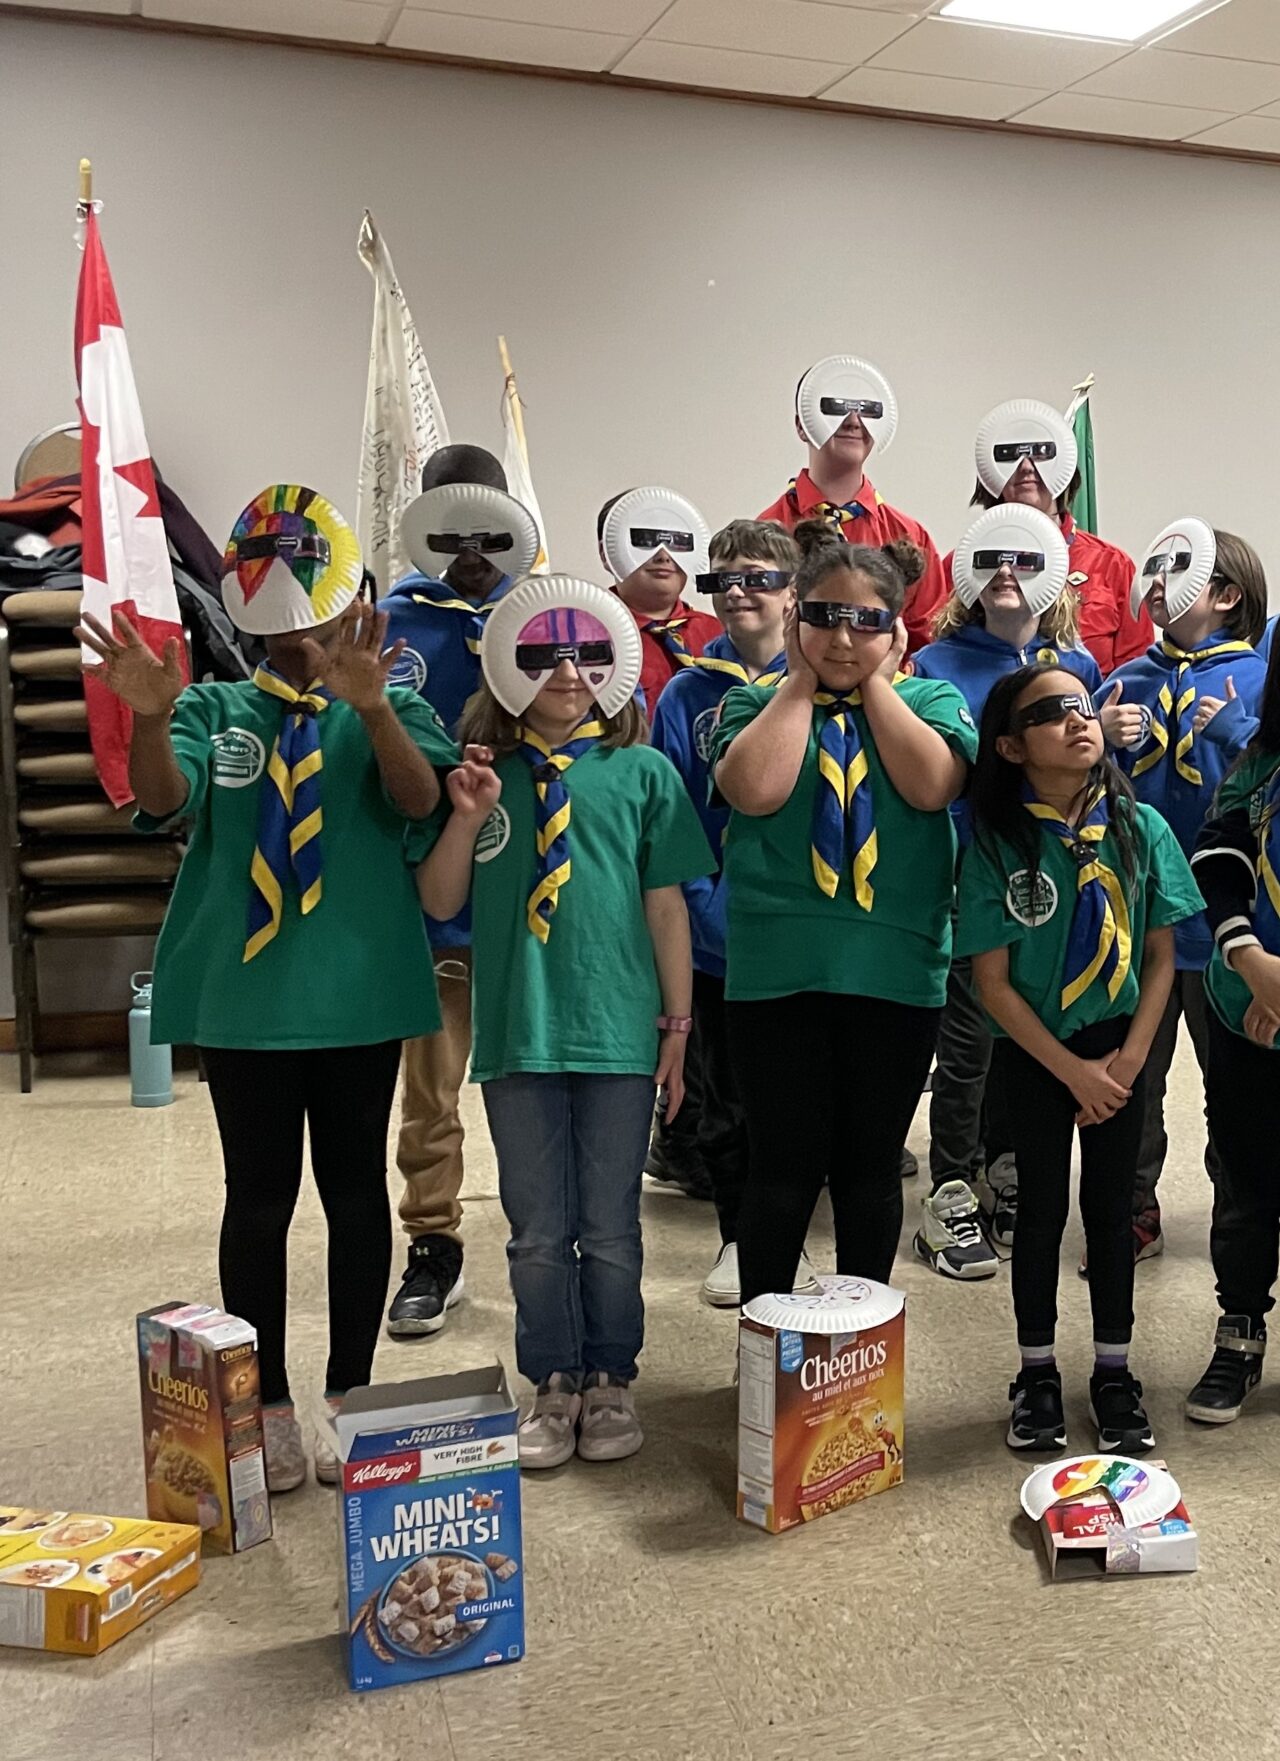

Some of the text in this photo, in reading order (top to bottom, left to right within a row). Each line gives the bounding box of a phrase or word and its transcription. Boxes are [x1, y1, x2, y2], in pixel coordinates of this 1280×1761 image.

[800, 1340, 887, 1391] Cheerios
[148, 1369, 209, 1412] Cheerios
[812, 1368, 885, 1402] au miel et aux noix
[433, 1445, 483, 1461] VERY HIGH
[456, 1453, 483, 1464] FIBRE
[352, 1461, 413, 1484] Kellogg's
[348, 1496, 365, 1593] MEGA JUMBO
[370, 1515, 499, 1562] WHEATS!
[463, 1598, 515, 1616] ORIGINAL
